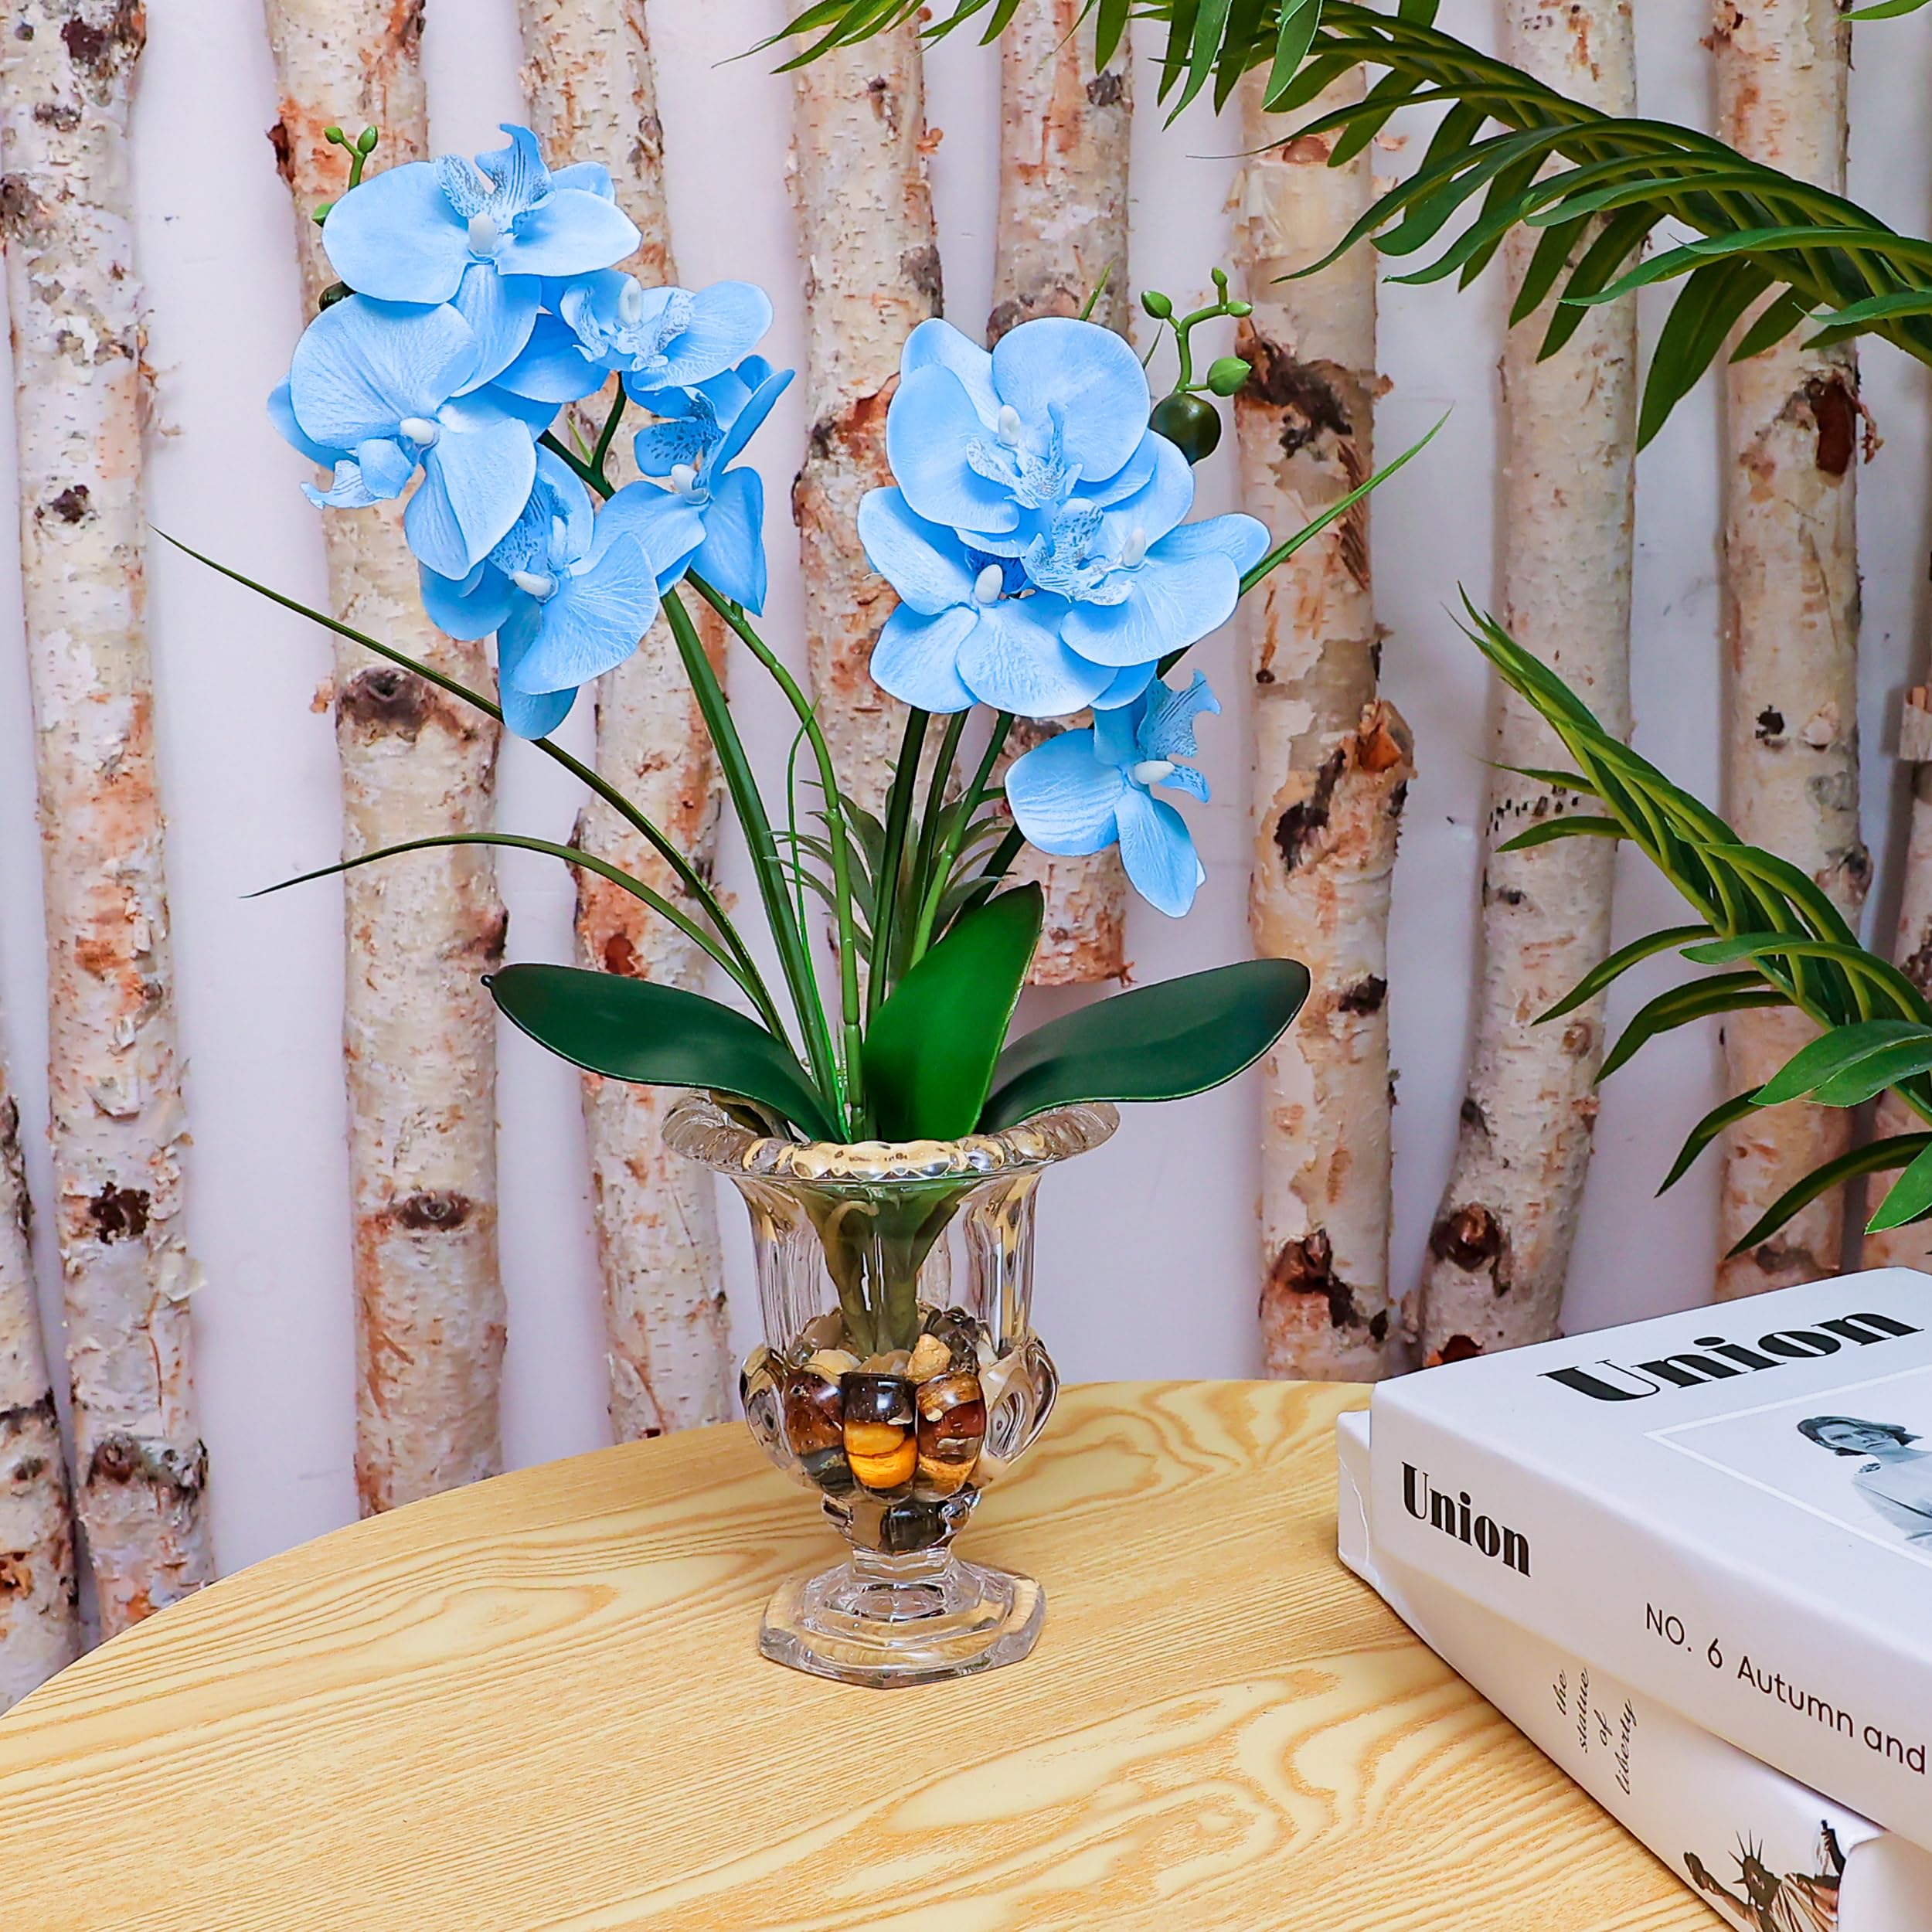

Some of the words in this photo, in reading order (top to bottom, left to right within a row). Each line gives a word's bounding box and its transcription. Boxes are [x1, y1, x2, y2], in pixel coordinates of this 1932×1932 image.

[1536, 1312, 1925, 1402] Union
[1401, 1461, 1532, 1578] Union
[1552, 1669, 1567, 1716] the
[1577, 1667, 1589, 1754] statue
[1594, 1709, 1613, 1747] of
[1646, 1602, 1692, 1652] NO.
[1707, 1638, 1723, 1669] 6
[1736, 1655, 1854, 1738] Autumn
[1863, 1726, 1926, 1775] and
[1614, 1698, 1638, 1795] liberty
